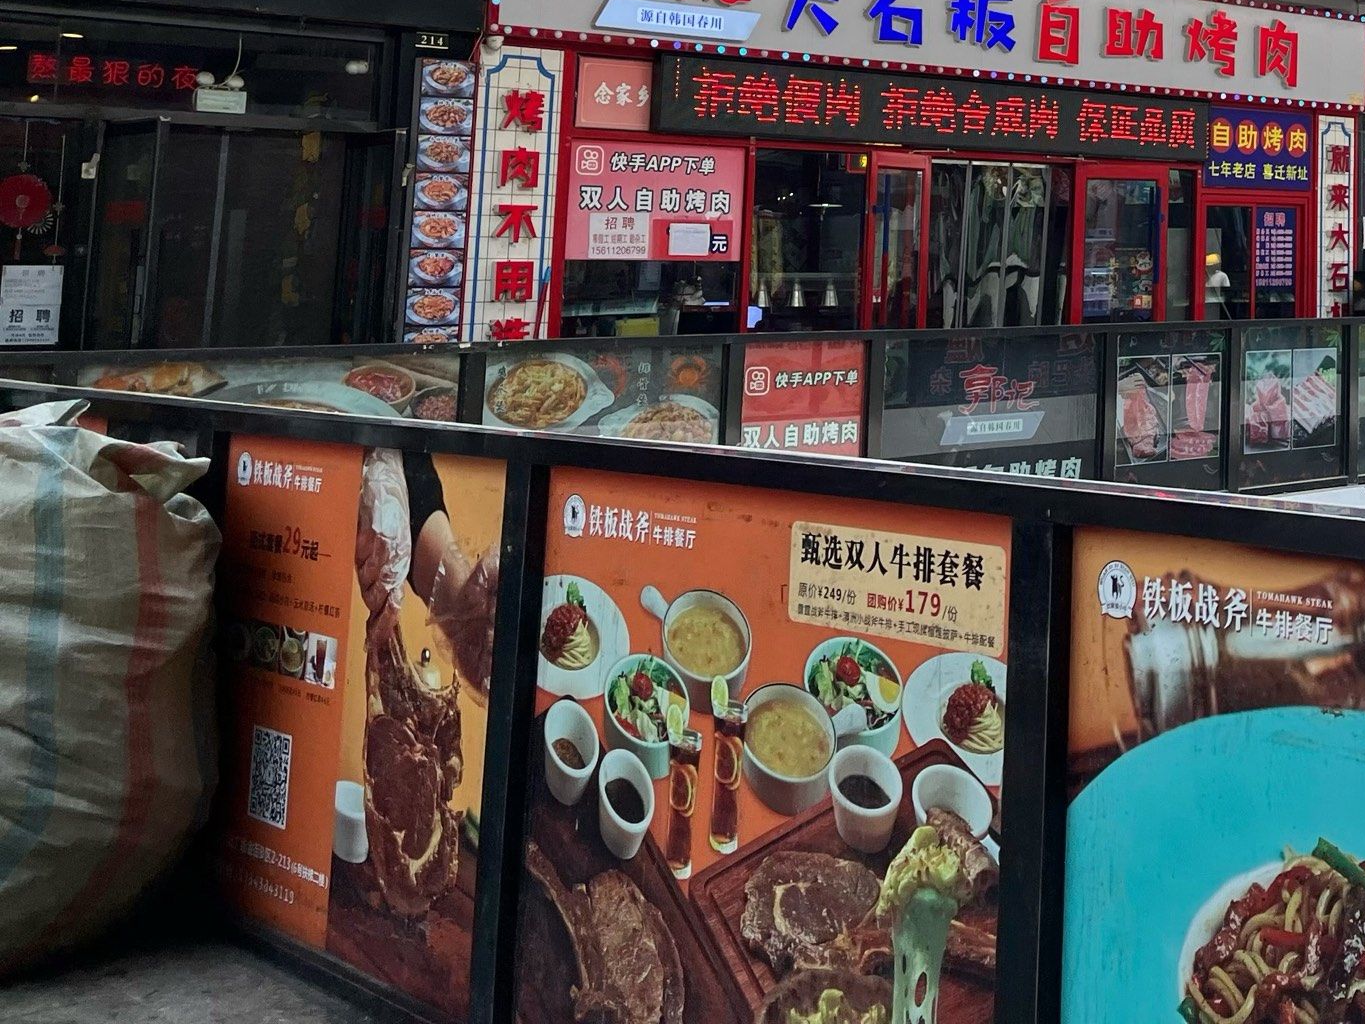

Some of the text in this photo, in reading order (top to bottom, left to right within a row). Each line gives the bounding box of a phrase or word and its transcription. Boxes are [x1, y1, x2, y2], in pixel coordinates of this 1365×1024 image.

[640, 8, 723, 30] 源自韩国春川
[420, 35, 445, 46] 214
[1211, 123, 1308, 153] 自助烤肉
[610, 152, 716, 176] 快手APP下单
[1208, 161, 1309, 182] 七年老店 喜迁新址
[579, 185, 731, 214] 双人自助烤肉
[603, 216, 635, 231] 招聘
[711, 235, 728, 253] 元
[8, 309, 52, 324] 招聘
[774, 371, 859, 389] 快手APP下单
[957, 364, 1040, 415] 郭记
[742, 422, 859, 450] 双人自助烤肉
[588, 504, 650, 545] 铁板战斧
[653, 525, 697, 550] 牛排餐厅
[800, 532, 985, 592] 甄选双人牛排套餐
[1141, 575, 1249, 633] 铁板战斧
[1256, 590, 1334, 610] TOMAHAWK STEAK
[1255, 607, 1334, 646] 牛排餐厅
